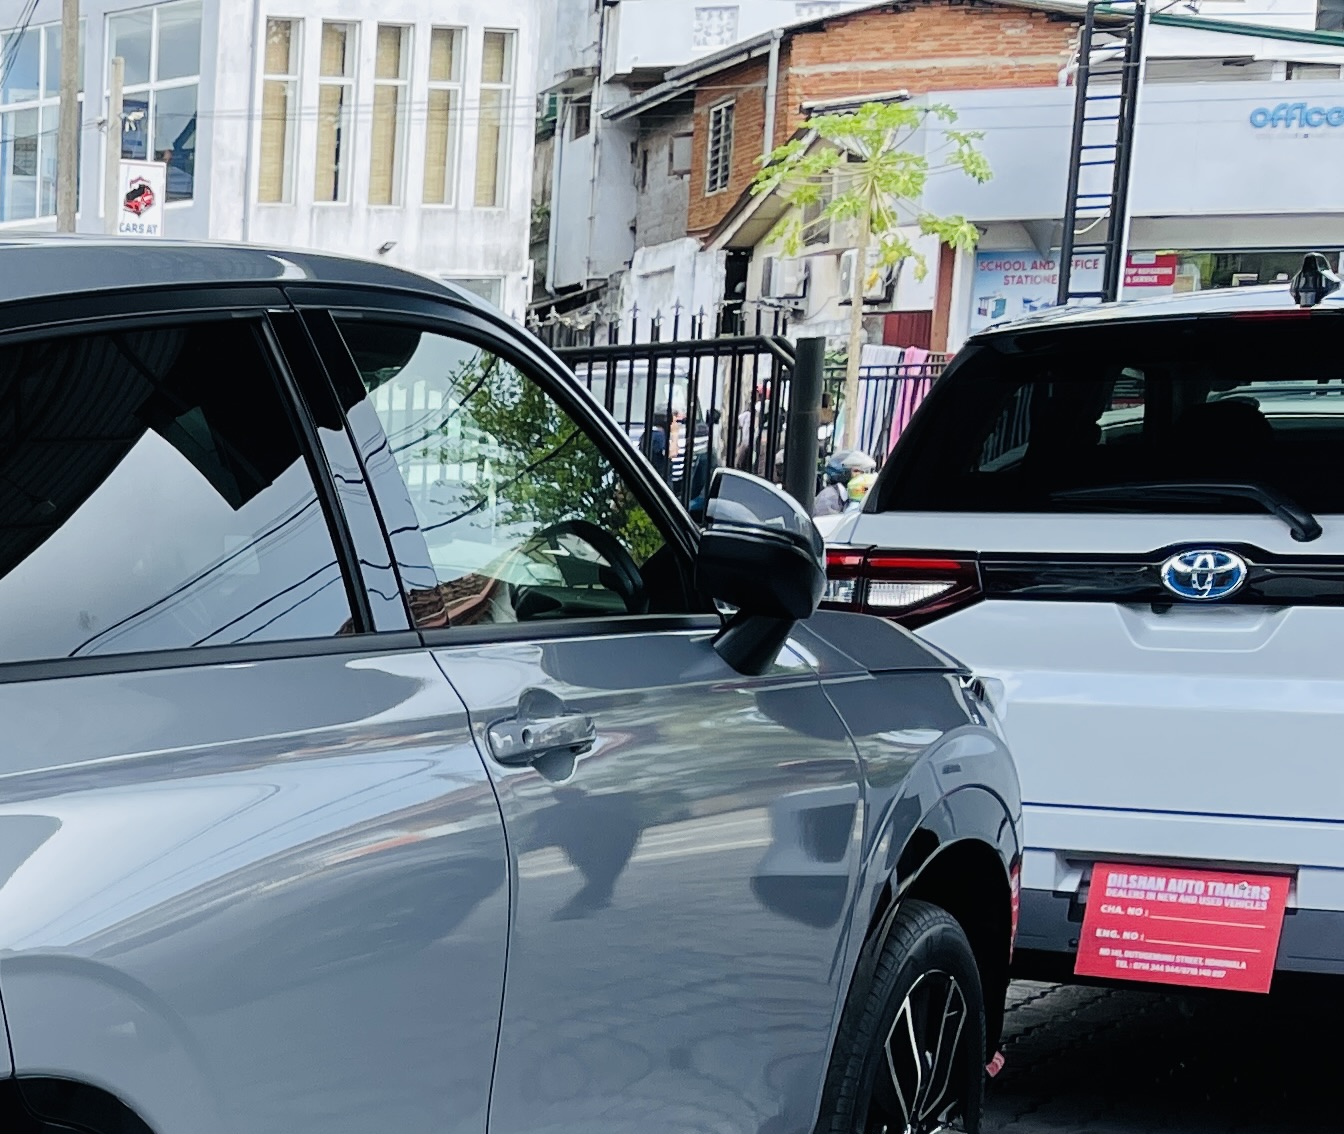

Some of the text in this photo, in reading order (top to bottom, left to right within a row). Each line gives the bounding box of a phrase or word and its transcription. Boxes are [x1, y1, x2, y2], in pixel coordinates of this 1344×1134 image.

[119, 223, 144, 233] CARS
[979, 258, 1100, 271] SCHOOL AND FFICE
[1003, 274, 1058, 286] STATIONE
[1167, 878, 1205, 896] AUTO
